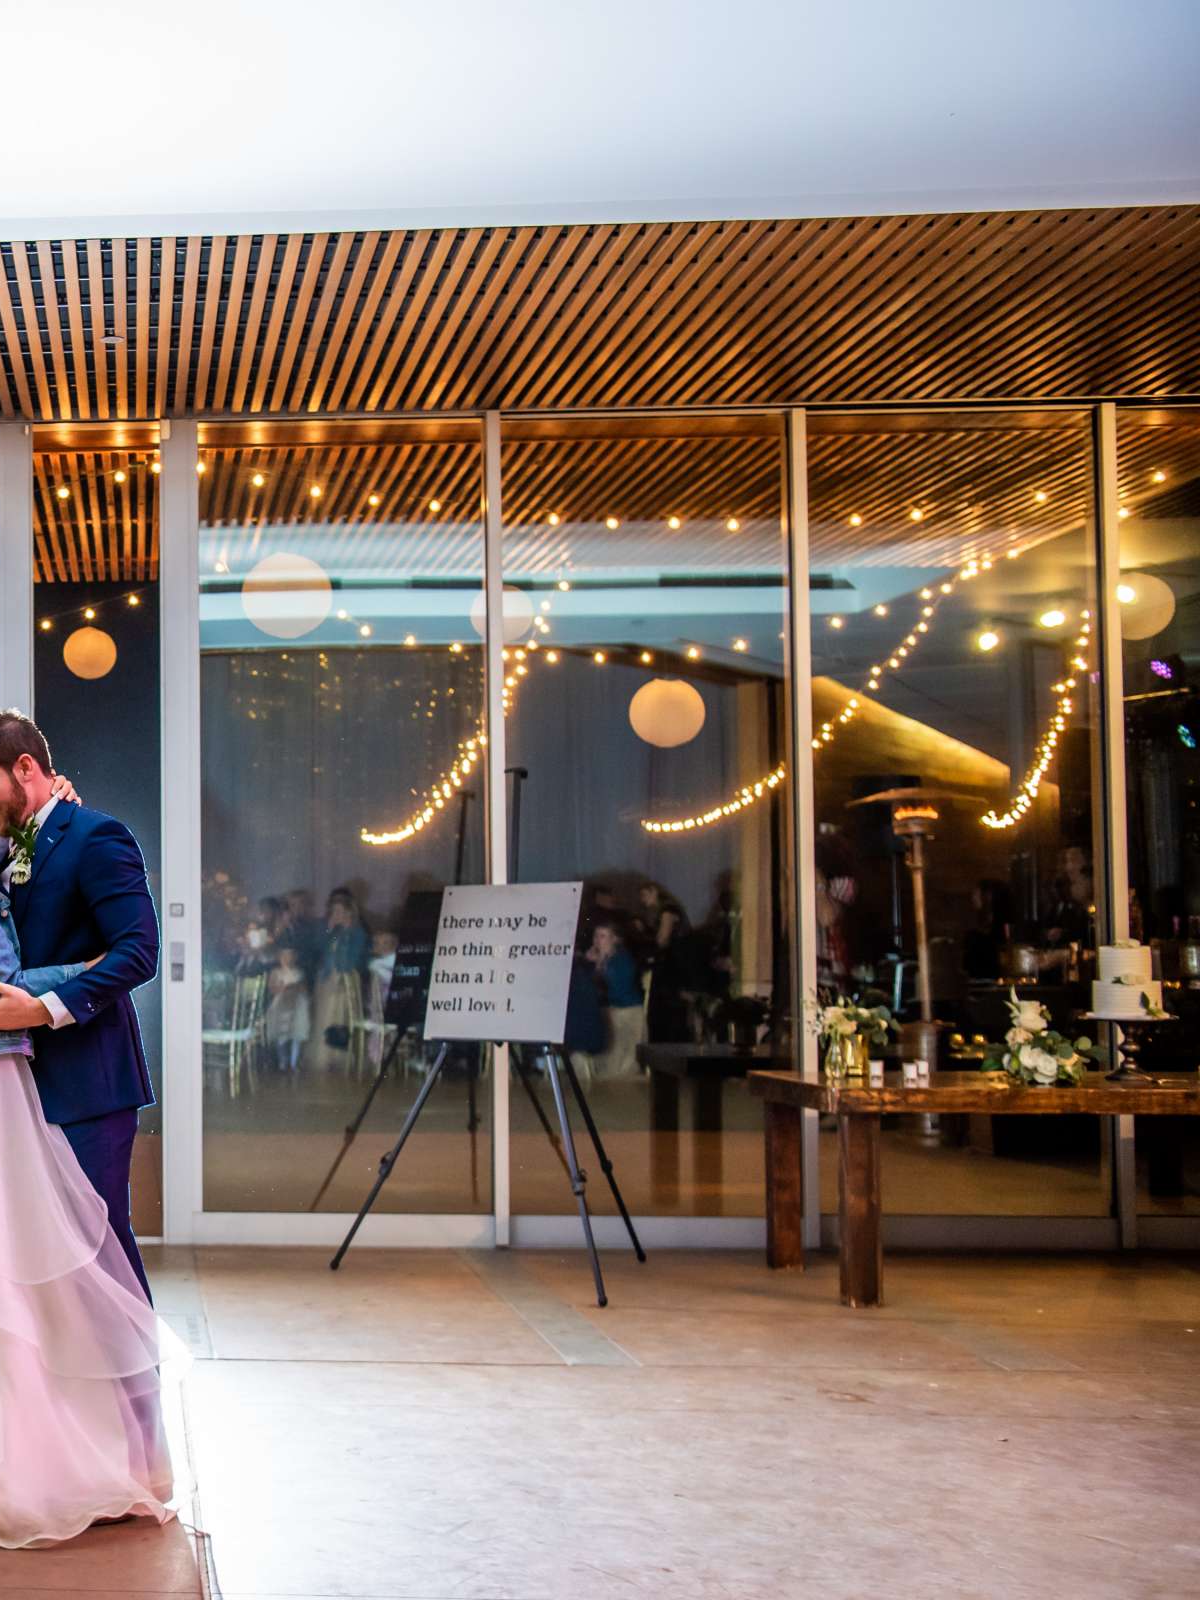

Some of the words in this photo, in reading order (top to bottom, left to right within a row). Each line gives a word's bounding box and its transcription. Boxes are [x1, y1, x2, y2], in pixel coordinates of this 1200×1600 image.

[442, 914, 484, 929] there
[528, 913, 548, 928] be
[462, 941, 502, 959] thin
[508, 942, 571, 960] greater
[434, 970, 470, 984] than
[474, 972, 483, 984] a
[489, 969, 515, 984] le
[431, 997, 463, 1012] well
